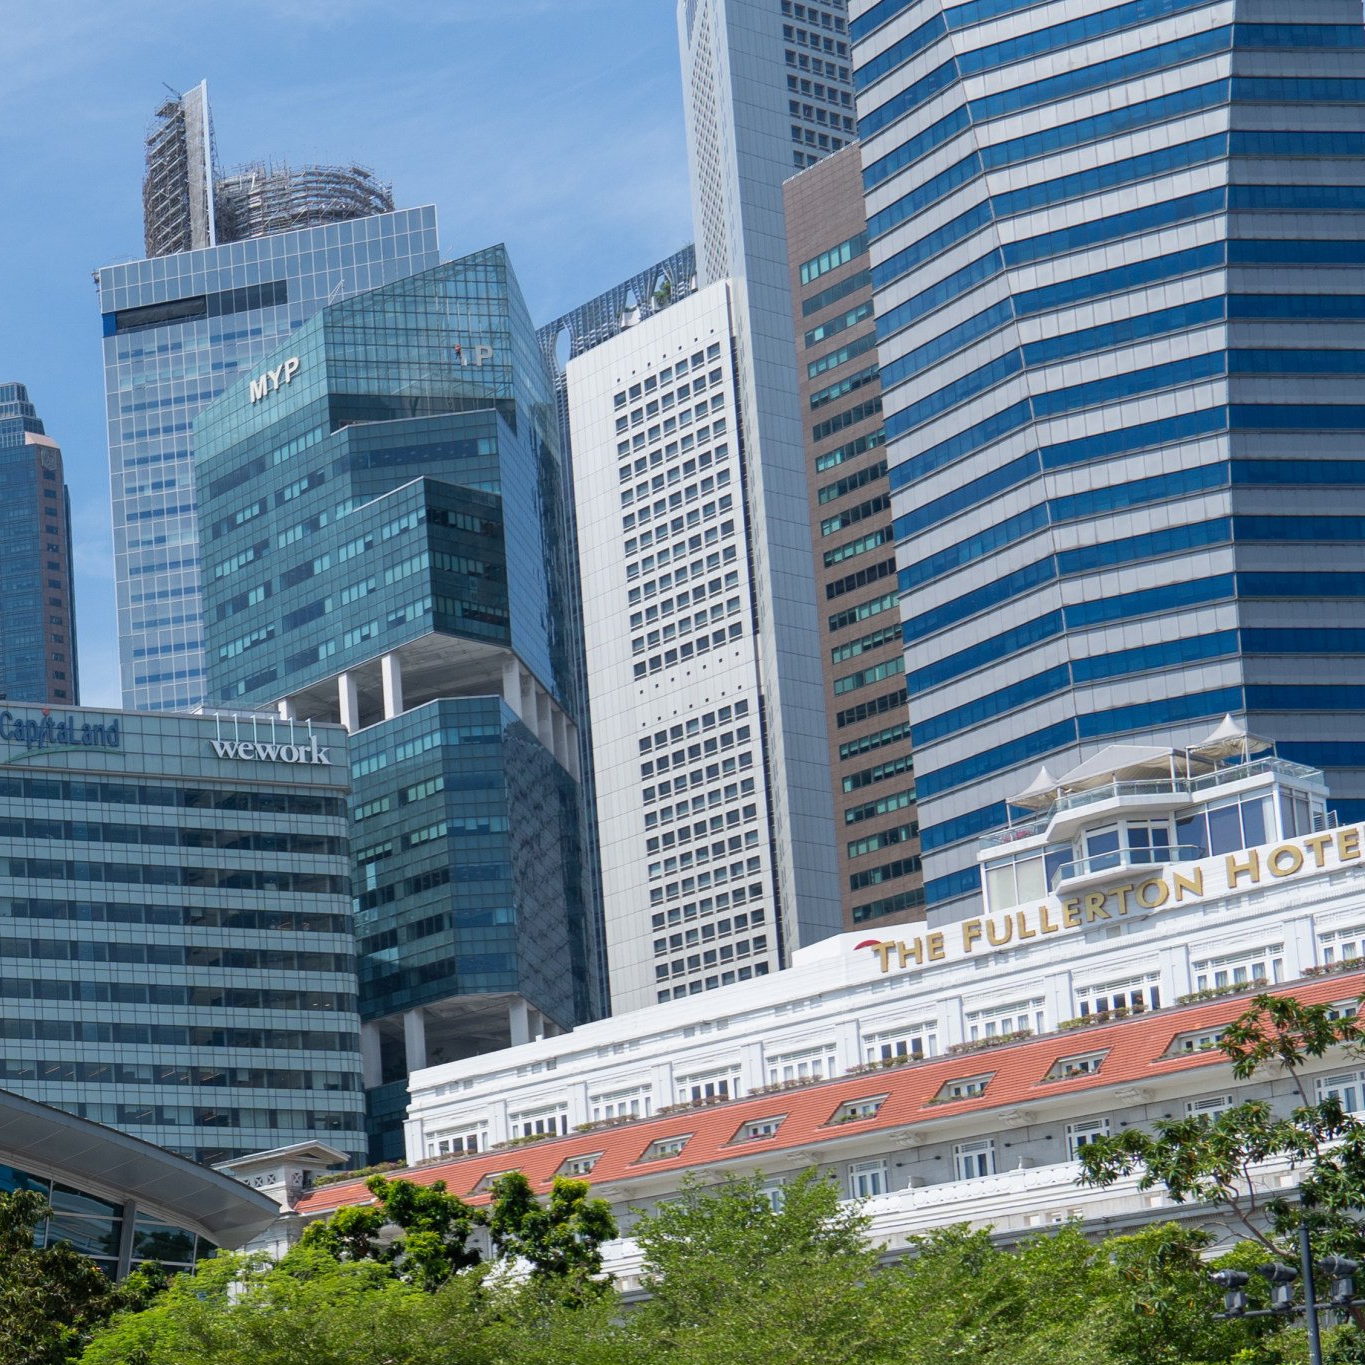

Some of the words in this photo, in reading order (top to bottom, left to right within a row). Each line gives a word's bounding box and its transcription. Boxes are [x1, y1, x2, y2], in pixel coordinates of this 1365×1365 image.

[249, 355, 300, 403] MYP
[210, 734, 333, 766] wework
[872, 931, 946, 973] THE
[962, 866, 1204, 952] FULLERTON
[1225, 827, 1362, 888] HOTE
